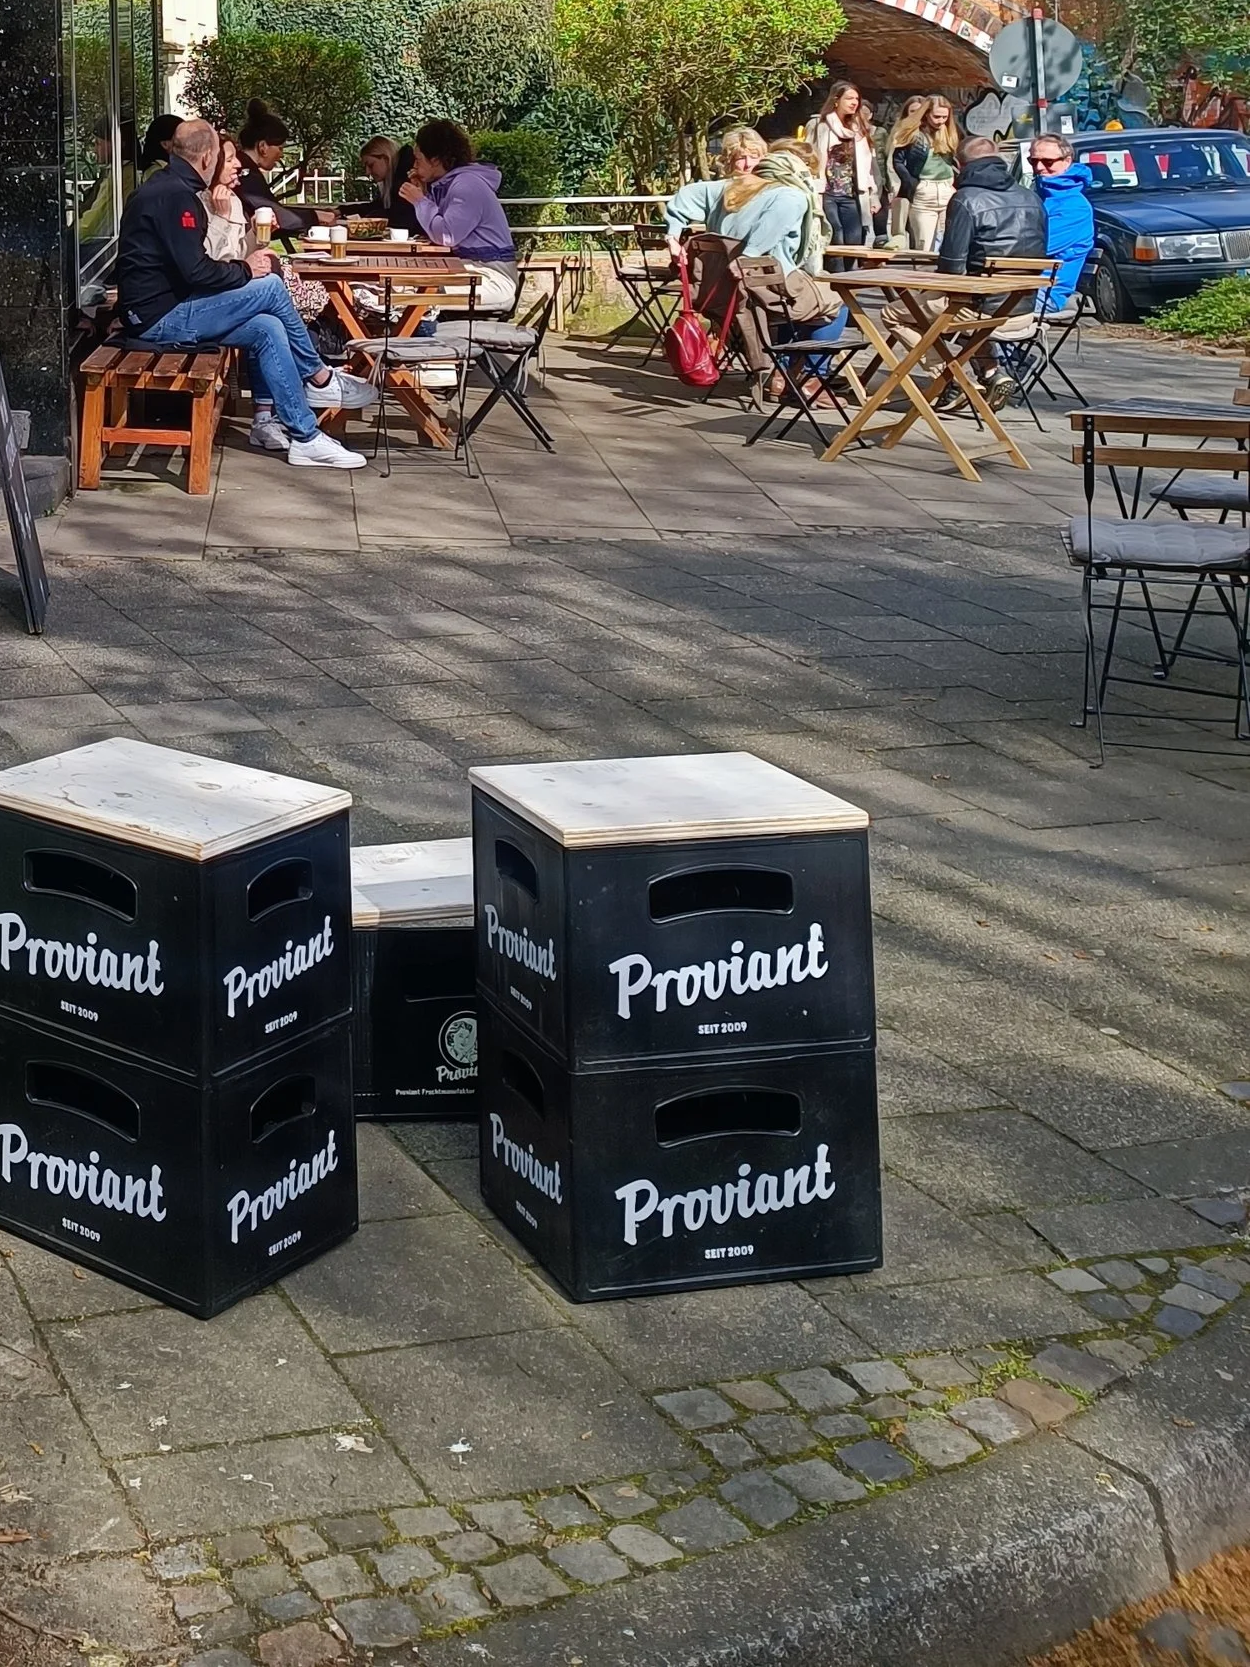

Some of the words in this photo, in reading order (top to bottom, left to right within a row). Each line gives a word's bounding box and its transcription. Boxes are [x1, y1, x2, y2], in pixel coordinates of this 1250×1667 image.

[223, 915, 334, 1018] Proviant
[485, 904, 557, 981] Proviant
[609, 922, 829, 1020] Proviant
[60, 999, 77, 1014] SEIT
[77, 1006, 99, 1022] 2009
[265, 1019, 280, 1033] SEIT
[280, 1011, 298, 1027] 2009
[698, 1023, 719, 1034] SEIT
[721, 1021, 747, 1034] 2009
[226, 1129, 339, 1244] Proviant
[489, 1112, 563, 1205] Proviant
[614, 1143, 836, 1247] Proviant
[62, 1217, 79, 1233] SEIT
[79, 1225, 101, 1242] 2009
[705, 1248, 727, 1259] SEIT
[727, 1244, 754, 1258] 2009
